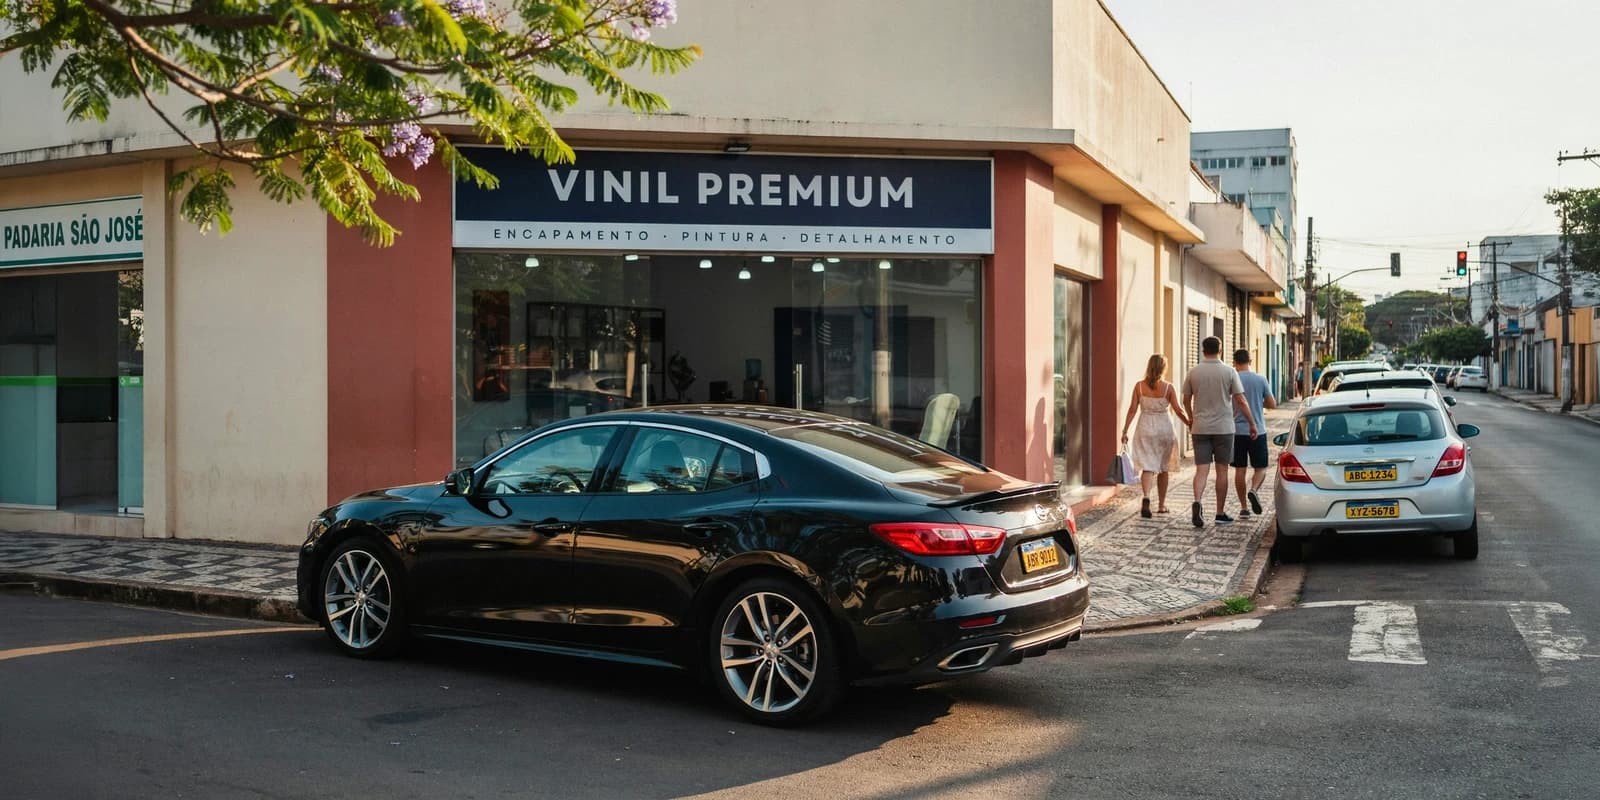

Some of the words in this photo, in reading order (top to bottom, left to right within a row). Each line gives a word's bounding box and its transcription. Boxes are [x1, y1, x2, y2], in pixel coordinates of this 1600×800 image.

[547, 169, 679, 203] VINIL
[698, 172, 913, 208] PREMIUM
[4, 221, 65, 249] PADARIA
[70, 213, 100, 246] SÃO
[105, 208, 143, 243] JOSÉ
[493, 228, 649, 241] ENCAPAMENTO
[682, 231, 768, 243] PINTURA
[800, 233, 955, 245] DETALHAMENTO
